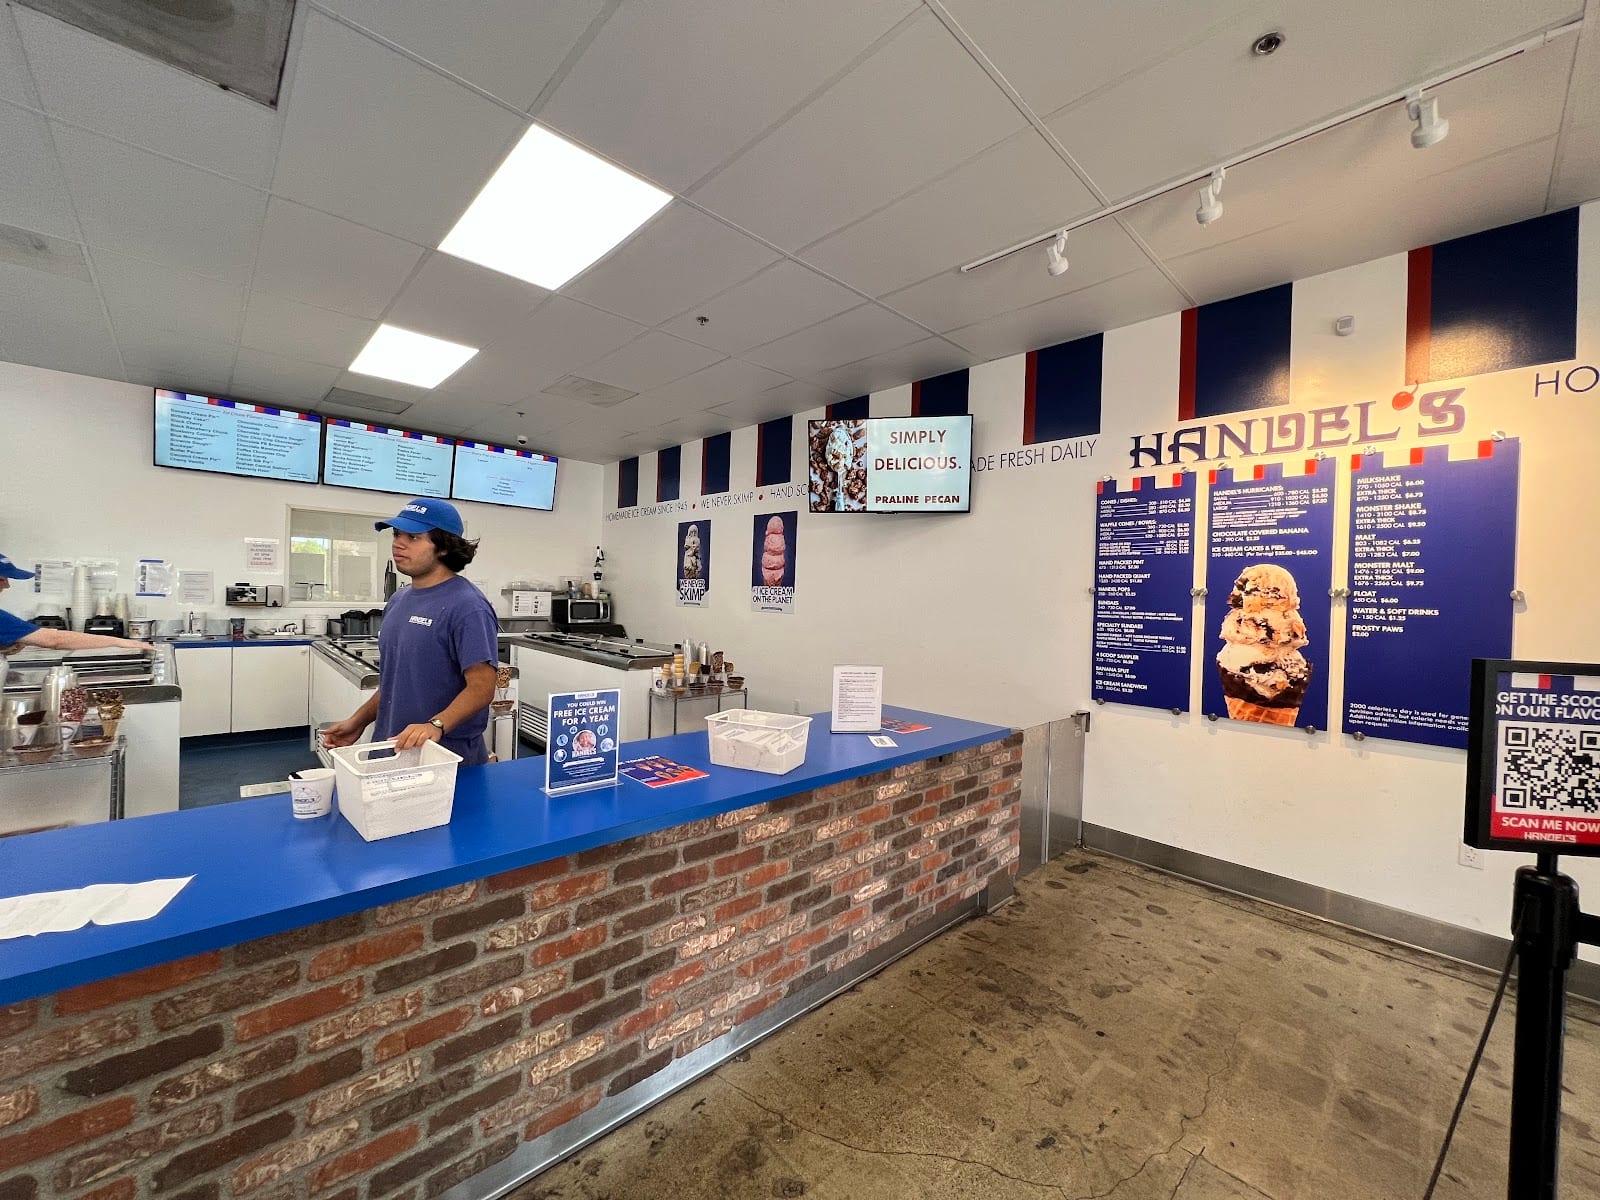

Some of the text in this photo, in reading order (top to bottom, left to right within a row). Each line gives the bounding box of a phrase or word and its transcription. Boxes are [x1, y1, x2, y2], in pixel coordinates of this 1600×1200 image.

[1129, 381, 1466, 469] HANDEL'S
[890, 430, 946, 444] SIMPLY
[1000, 448, 1044, 468] FRESH
[1051, 439, 1097, 461] DAILY
[875, 456, 962, 471] DELICIOUS.
[1357, 475, 1401, 484] MILKSHAKE
[770, 486, 793, 499] HAND
[701, 492, 753, 509] WE NEVER SKIMP
[605, 509, 631, 521] HOMEMADE
[640, 506, 656, 516] CREAM
[658, 504, 672, 514] SINCE
[688, 580, 705, 588] NEVER
[680, 588, 704, 601] SKIMP
[770, 588, 792, 596] CREAM
[1497, 691, 1526, 704] GET
[1530, 693, 1557, 705] THE
[554, 710, 572, 718] FREE
[589, 705, 615, 714] CREAM
[1517, 705, 1550, 718] OUR
[1409, 720, 1446, 729] information
[1502, 816, 1600, 832] SCAN ME NOW
